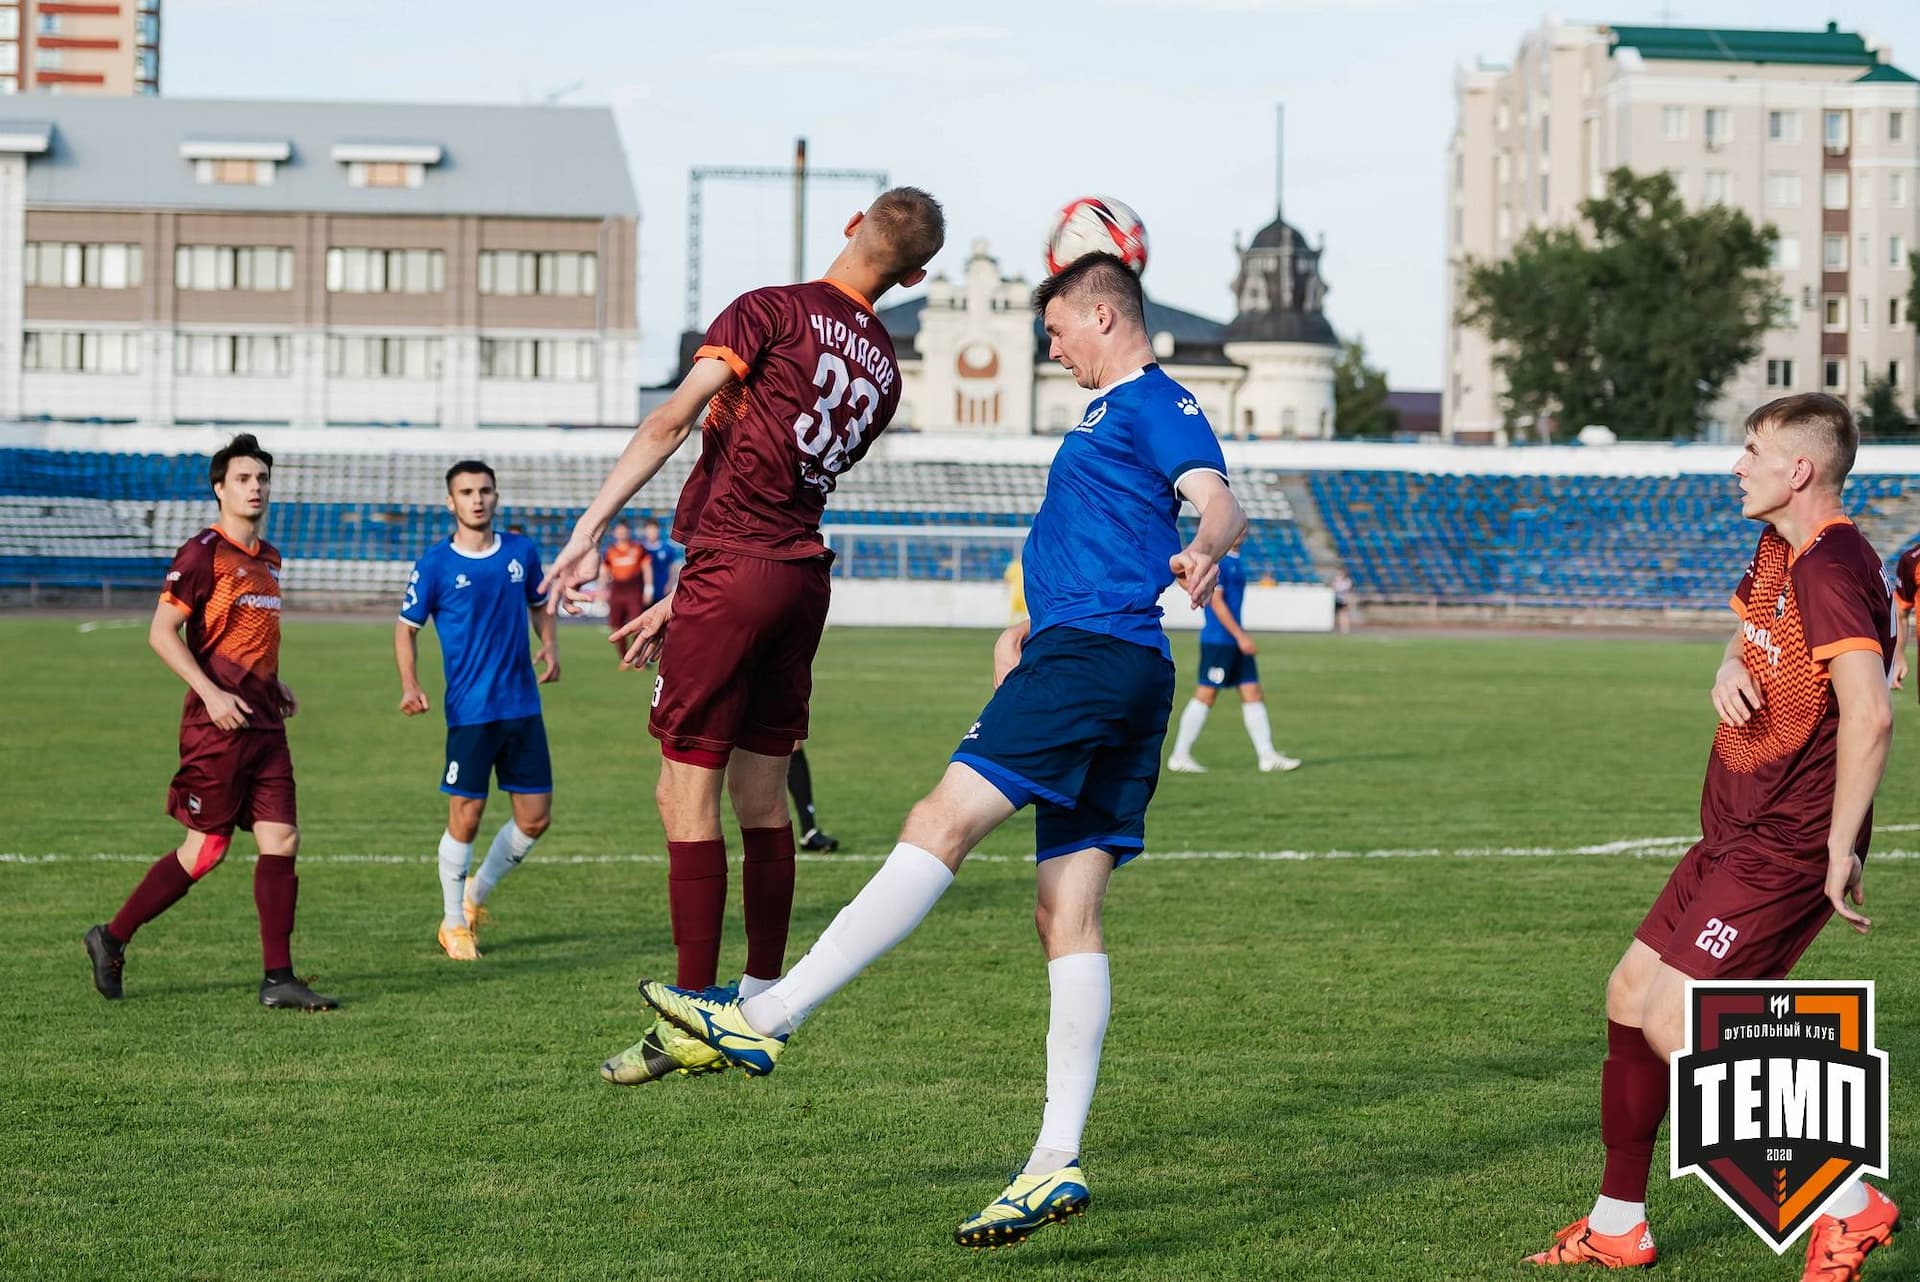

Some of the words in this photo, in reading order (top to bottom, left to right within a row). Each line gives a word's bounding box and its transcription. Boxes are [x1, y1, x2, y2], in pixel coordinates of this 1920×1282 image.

[810, 314, 895, 396] ЧЕРКАСОВ
[793, 352, 880, 473] 33
[446, 760, 459, 785] 8
[1694, 917, 1738, 959] 25
